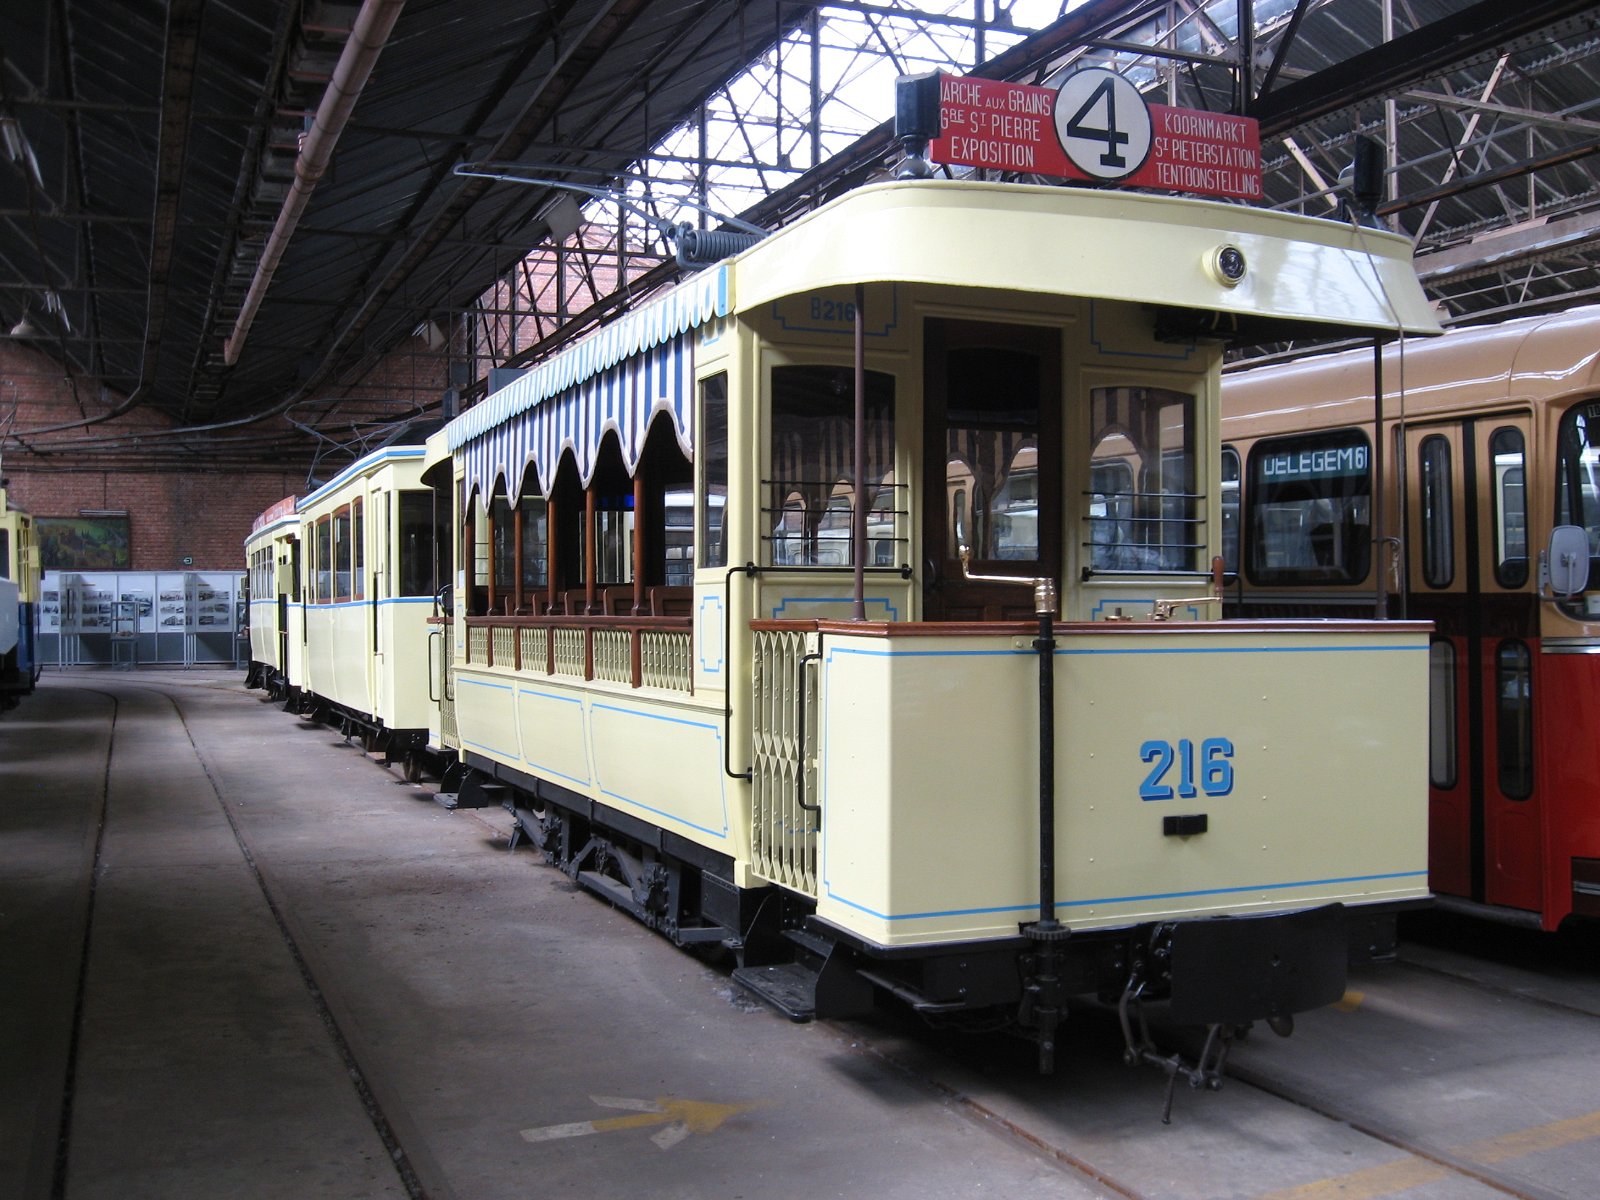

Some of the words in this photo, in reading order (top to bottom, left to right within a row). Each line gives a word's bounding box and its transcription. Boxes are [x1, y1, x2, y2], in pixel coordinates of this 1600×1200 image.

[985, 97, 1006, 110] AUX
[1008, 90, 1051, 116] GRAINS
[991, 114, 1041, 142] PIERRE
[1067, 77, 1128, 168] 4
[1164, 112, 1247, 144] KOORNMARKT
[951, 135, 1035, 168] EXPOSITION
[1172, 138, 1256, 170] PIETERSTATION
[1156, 162, 1260, 196] TENTOONSTELLING
[811, 298, 855, 321] B216
[1140, 738, 1234, 801] 216
